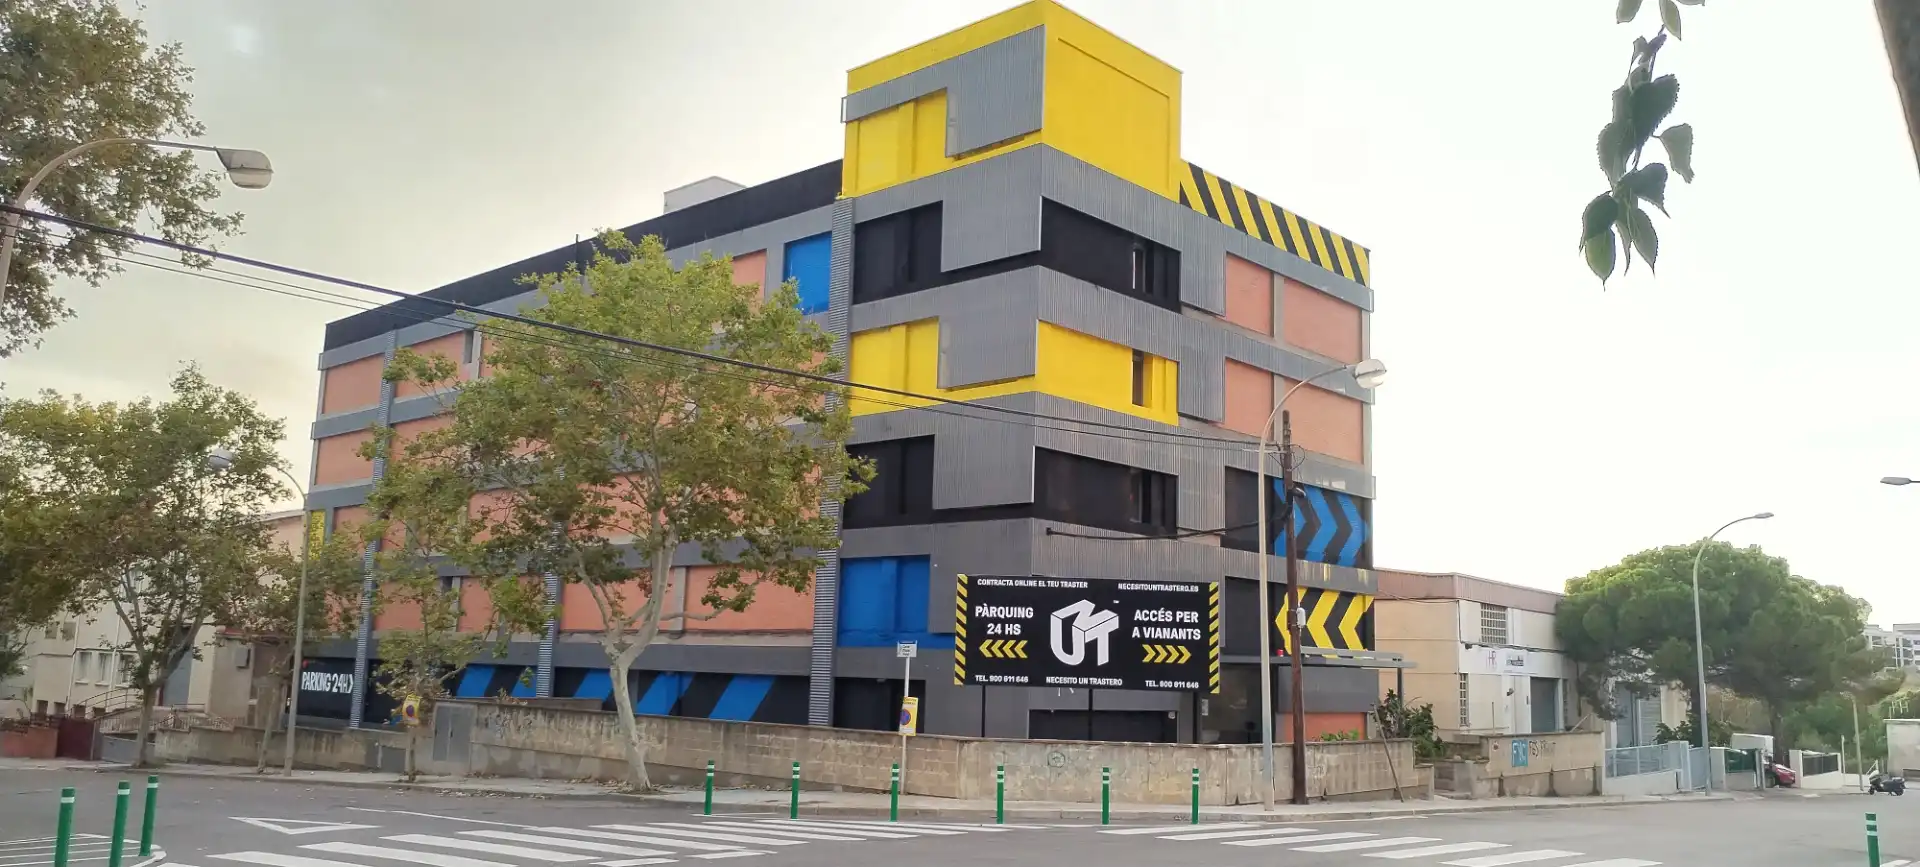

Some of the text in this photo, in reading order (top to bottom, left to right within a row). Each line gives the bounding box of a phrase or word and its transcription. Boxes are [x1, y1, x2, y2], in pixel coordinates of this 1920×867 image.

[977, 578, 1014, 587] CONTRACTA
[1060, 581, 1088, 589] TRASTER
[975, 603, 1034, 619] PÀRQUING
[1134, 607, 1199, 623] ACCÉS PER
[987, 622, 1021, 635] 24 HS
[1132, 626, 1201, 640] A VIANANTS
[301, 671, 331, 692] PARKING
[1046, 676, 1078, 685] NECESITO
[1089, 678, 1123, 686] TRASTERO
